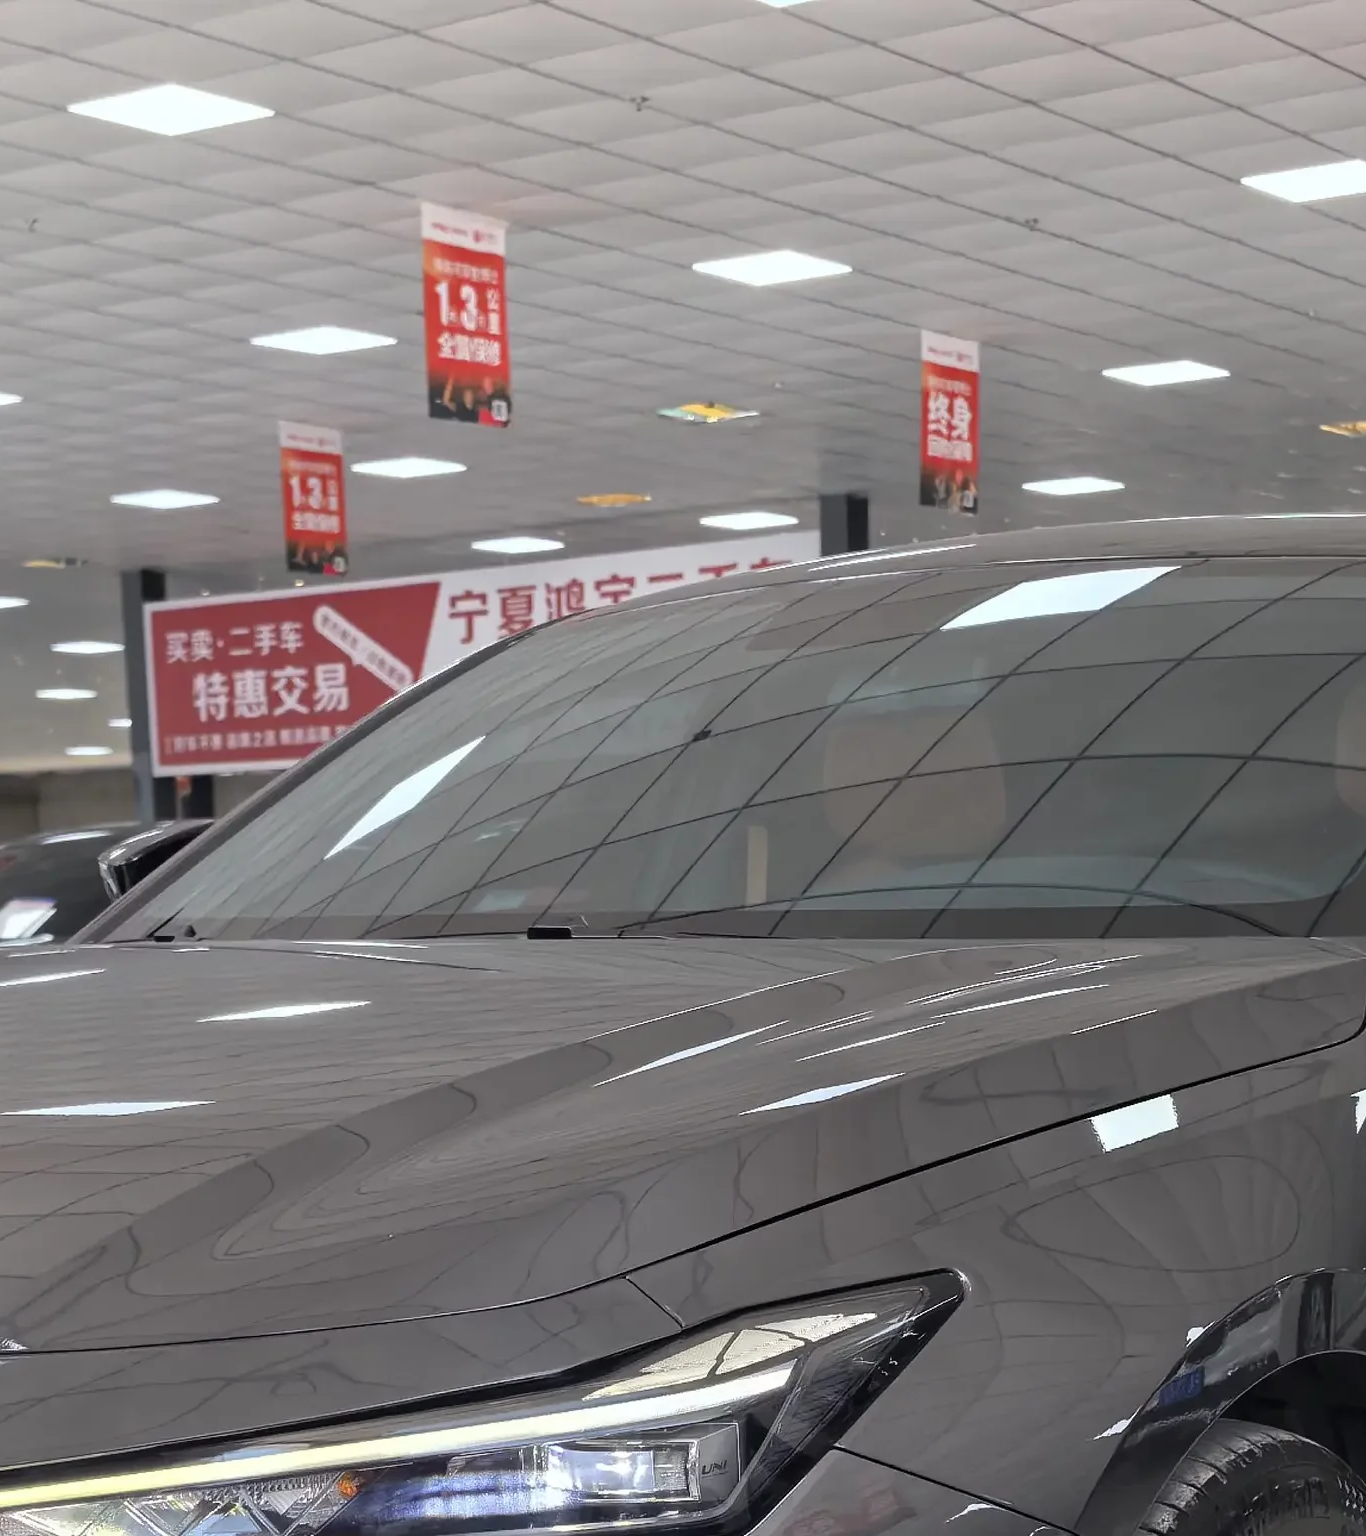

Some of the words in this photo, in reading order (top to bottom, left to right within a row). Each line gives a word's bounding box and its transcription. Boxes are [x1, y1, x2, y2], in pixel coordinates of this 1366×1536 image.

[928, 391, 973, 441] 终身
[193, 662, 351, 723] 特惠交易
[702, 1460, 728, 1475] UNI
